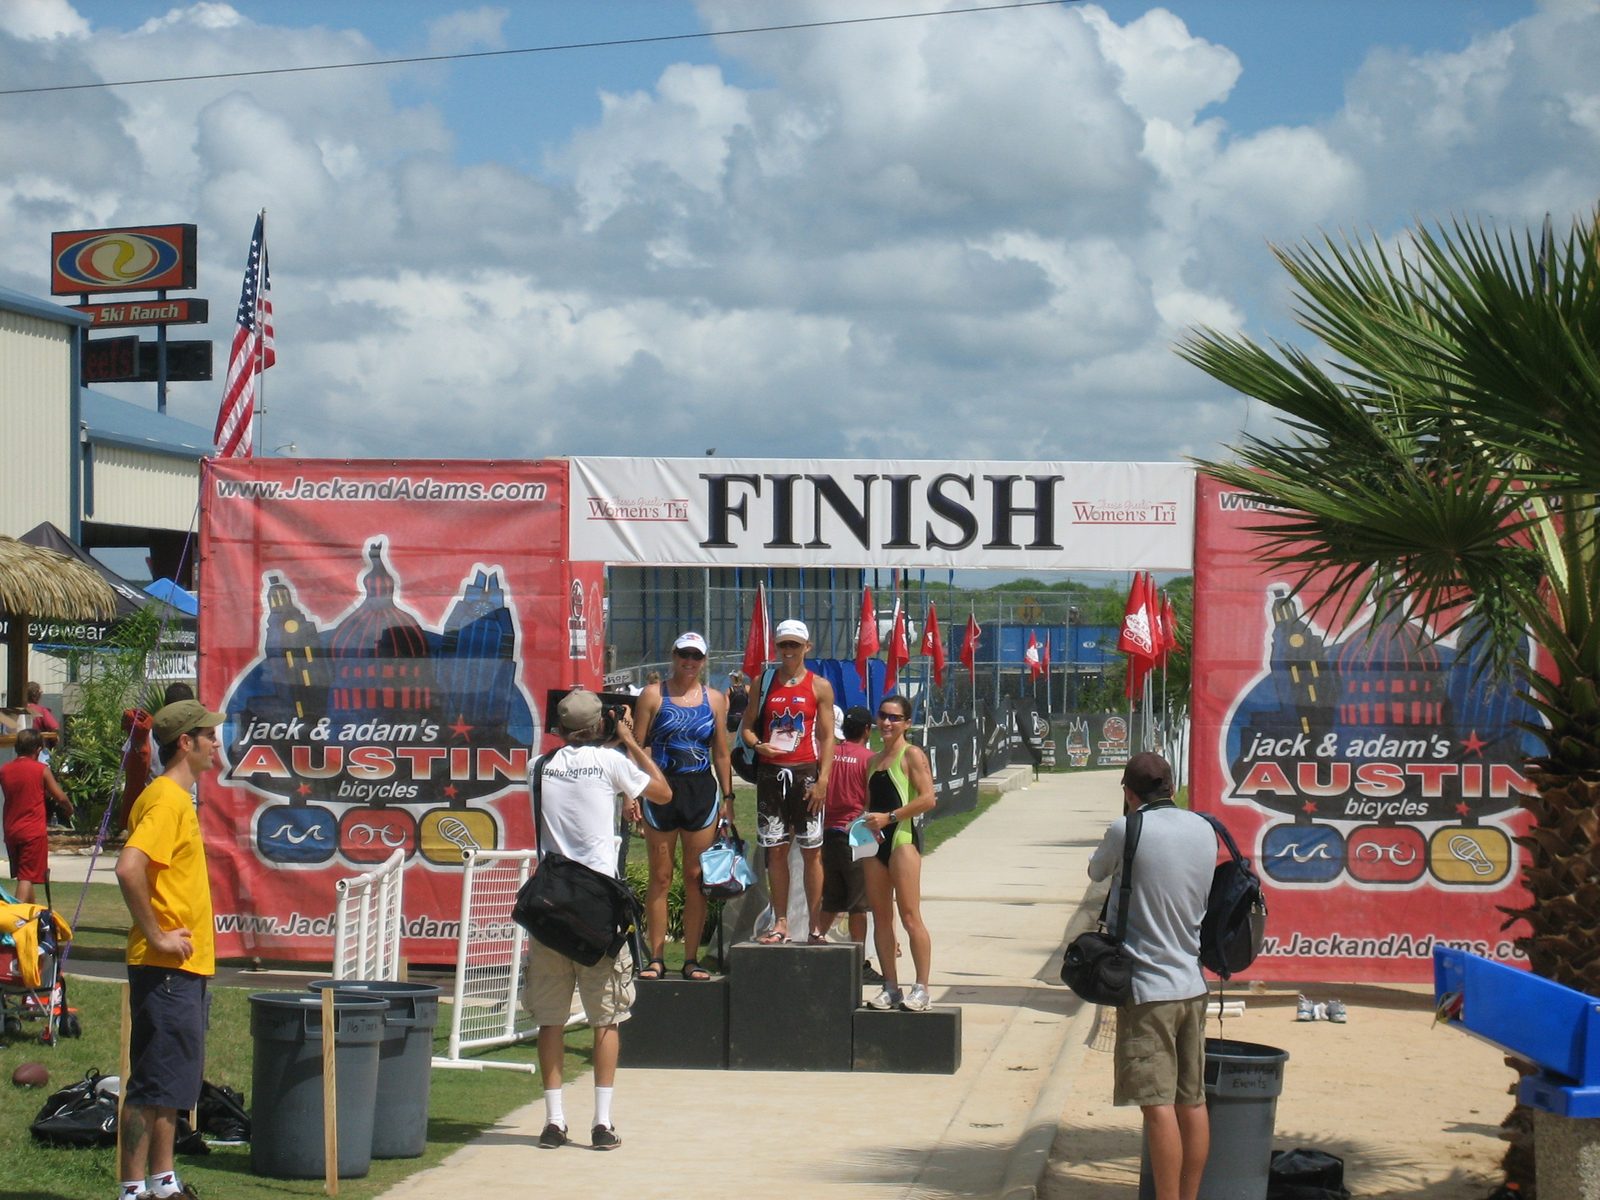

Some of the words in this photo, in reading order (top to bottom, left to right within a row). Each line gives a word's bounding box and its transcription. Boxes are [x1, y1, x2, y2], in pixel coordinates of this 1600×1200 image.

[100, 307, 125, 322] Ski
[129, 303, 179, 321] Ranch
[216, 476, 547, 501] www.JackandAdams.com
[588, 500, 660, 519] Women's
[663, 502, 689, 519] Tri
[699, 472, 1065, 551] FINISH
[1073, 505, 1147, 521] Women's
[1150, 505, 1177, 521] Tri
[28, 622, 107, 641] eyewear
[239, 717, 301, 746] jack
[309, 717, 332, 742] &
[338, 717, 440, 743] adam's
[1243, 732, 1311, 763] jack
[1316, 733, 1338, 758] &
[1345, 733, 1451, 758] adam's
[231, 745, 529, 781] AUSTIN
[337, 780, 419, 800] bicycles
[1236, 761, 1542, 798] AUSTIN
[1344, 797, 1429, 819] bicycles
